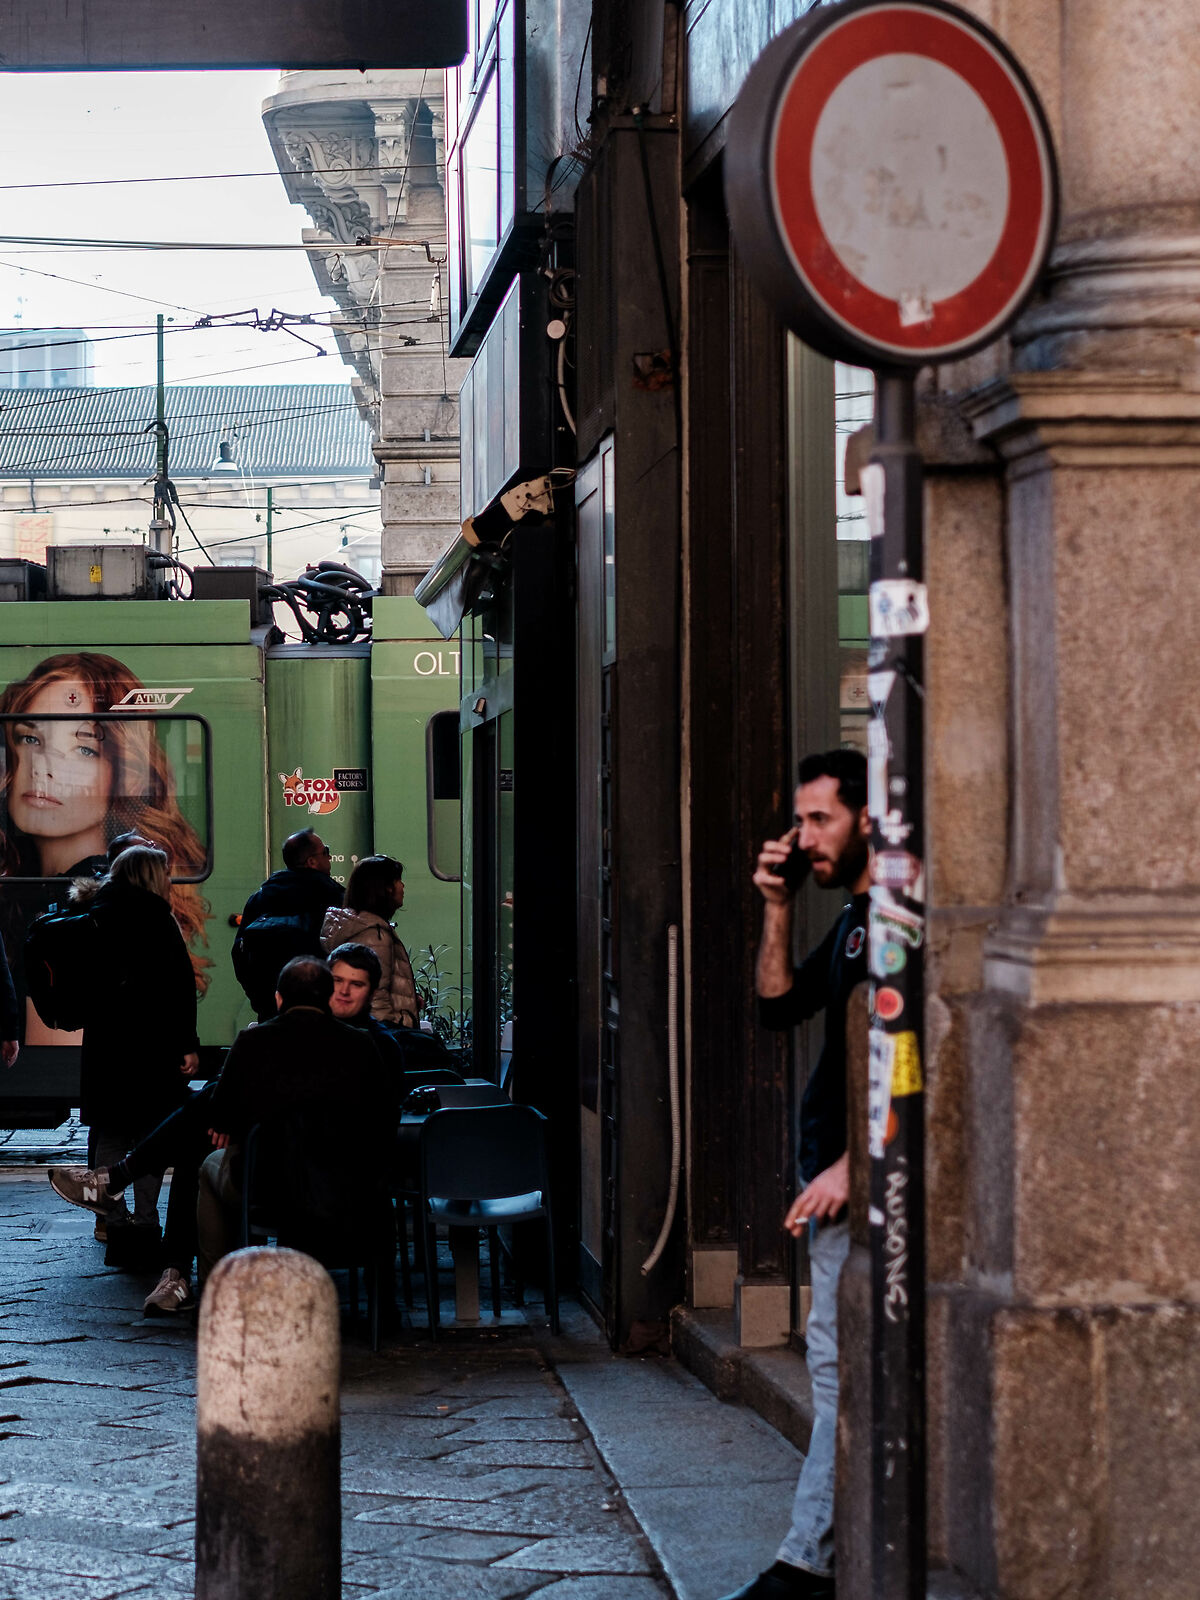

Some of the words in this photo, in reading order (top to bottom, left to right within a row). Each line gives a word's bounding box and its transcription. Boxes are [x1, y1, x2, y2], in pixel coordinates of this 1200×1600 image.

[413, 651, 461, 676] OLT
[134, 693, 167, 705] ATM
[303, 779, 338, 792] FOX
[337, 780, 363, 788] STORES
[284, 792, 338, 805] TOWN
[83, 1186, 97, 1201] N
[173, 1286, 187, 1301] N
